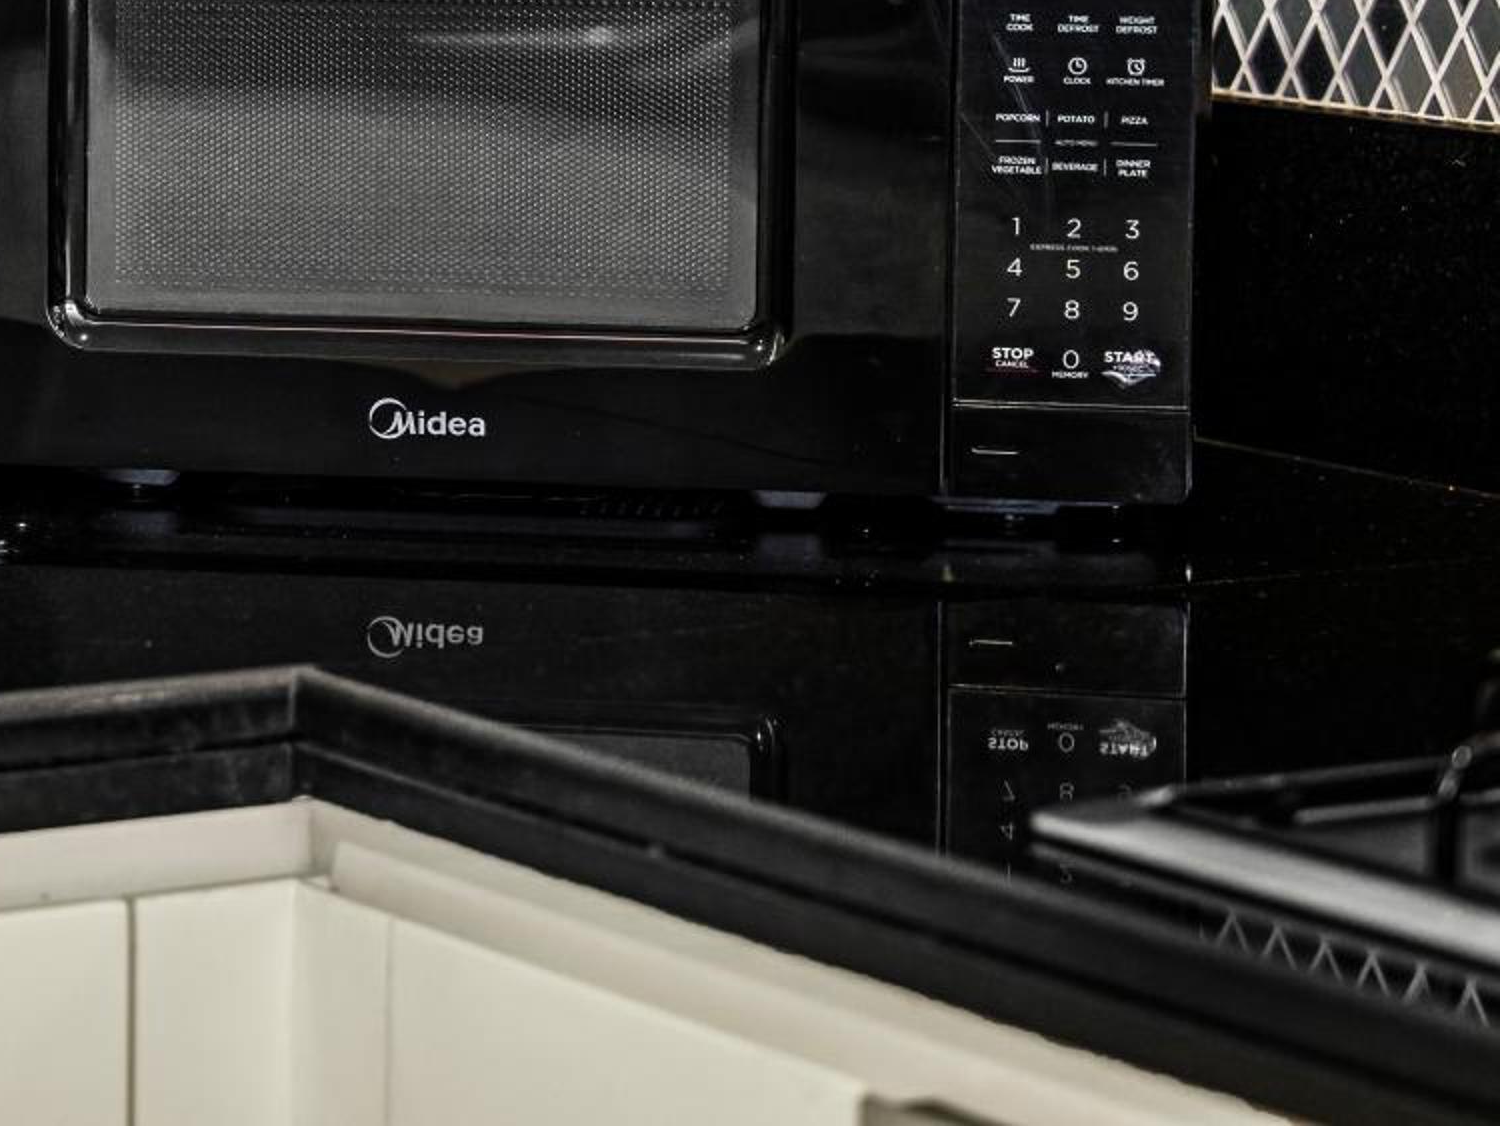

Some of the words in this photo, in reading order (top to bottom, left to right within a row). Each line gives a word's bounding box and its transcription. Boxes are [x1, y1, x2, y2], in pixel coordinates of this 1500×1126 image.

[1057, 24, 1099, 33] DEFROST
[1116, 25, 1157, 34] DEFROST
[1063, 76, 1092, 85] CLOCK
[995, 113, 1041, 123] POPCORN
[1057, 115, 1095, 124] POTATO
[1121, 116, 1149, 125] PIZZA
[998, 156, 1036, 165] FROZEN
[1051, 161, 1099, 172] BEVERAGE
[1115, 159, 1151, 168] DINNER
[991, 165, 1042, 175] VEGETABLE
[1118, 169, 1148, 178] PLATE
[1012, 217, 1021, 236] 1
[1066, 218, 1082, 239] 2
[1125, 219, 1140, 240] 3
[1007, 257, 1023, 277] 4
[1065, 259, 1081, 279] 5
[1123, 261, 1139, 281] 6
[1006, 297, 1022, 317] 7
[1063, 299, 1080, 320] 8
[1123, 301, 1139, 321] 9
[991, 347, 1035, 360] STOP
[1062, 349, 1080, 370] 0
[1104, 350, 1156, 364] START
[369, 397, 487, 439] Midea
